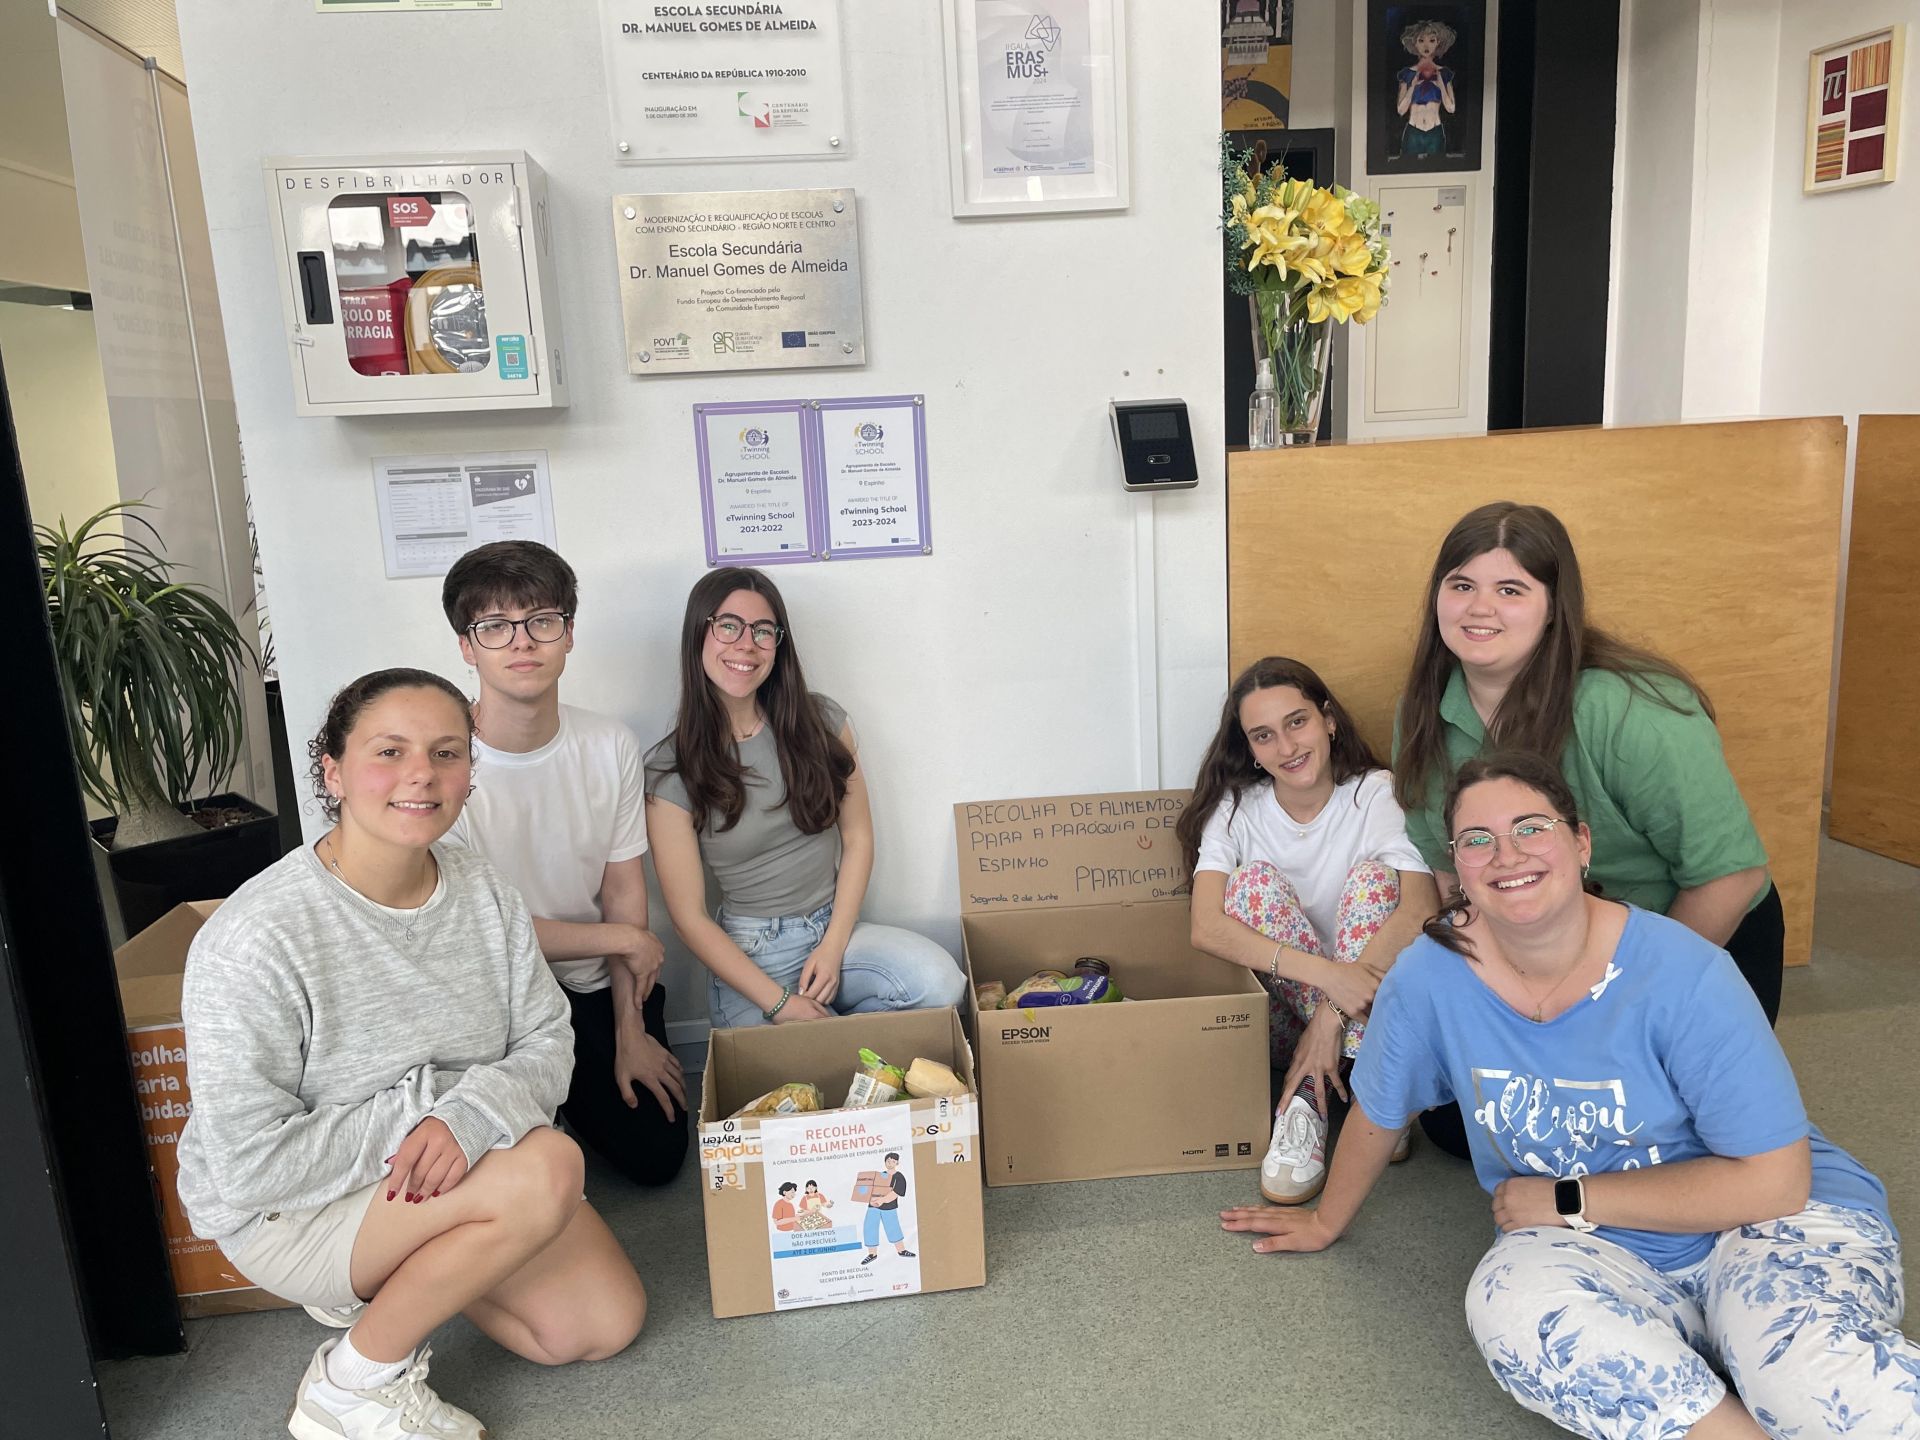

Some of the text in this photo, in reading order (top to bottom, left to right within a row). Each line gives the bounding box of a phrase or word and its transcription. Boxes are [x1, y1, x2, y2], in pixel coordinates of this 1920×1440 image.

[654, 2, 782, 17] ESCOLA SECUNDÁRIA
[622, 20, 817, 34] DR. MANUEL GOMES DE ALMEIDA
[1006, 51, 1045, 65] ERAS
[642, 67, 806, 80] CENTENÁRIO DA REPÚBLICA 1910-2010
[1007, 65, 1049, 79] MUS+
[645, 105, 688, 113] INAUGURAÇÃO
[285, 172, 504, 190] DESFIBRILHADOR
[392, 202, 419, 214] SOS
[644, 213, 706, 224] MODERNIZAÇÃO
[714, 212, 778, 222] REQUALIFICAÇÃO
[791, 211, 824, 219] ESCOLAS
[635, 226, 655, 234] COM
[688, 223, 735, 232] SECUNDÁRIO
[742, 221, 771, 230] REGIÃO
[805, 220, 836, 228] CENTRO
[669, 240, 802, 258] Escola Secundária
[630, 258, 848, 279] Dr. Manuel Gomes de Almeida
[377, 309, 393, 322] DE
[345, 325, 394, 339] RRAGIA
[653, 337, 675, 347] POVT
[726, 512, 795, 522] eTwinning School
[840, 505, 907, 515] eTwinning School
[740, 525, 783, 533] 2021-2022
[852, 518, 896, 527] 2023-2024
[966, 798, 1184, 828] RECOLHA DE ALIMENTOS
[971, 830, 1022, 851] PARA
[1033, 828, 1044, 840] A
[1146, 816, 1176, 829] DE
[979, 856, 1049, 873] ESPINHO
[970, 893, 1008, 905] Segunda
[1021, 894, 1033, 902] de
[1215, 1013, 1251, 1024] EB-735F
[1001, 1026, 1050, 1040] EPSON
[703, 1134, 741, 1144] Payten
[805, 1123, 866, 1141] RECOLHA
[790, 1134, 884, 1156] DE ALIMENTOS
[804, 1230, 836, 1238] ALIMENTOS
